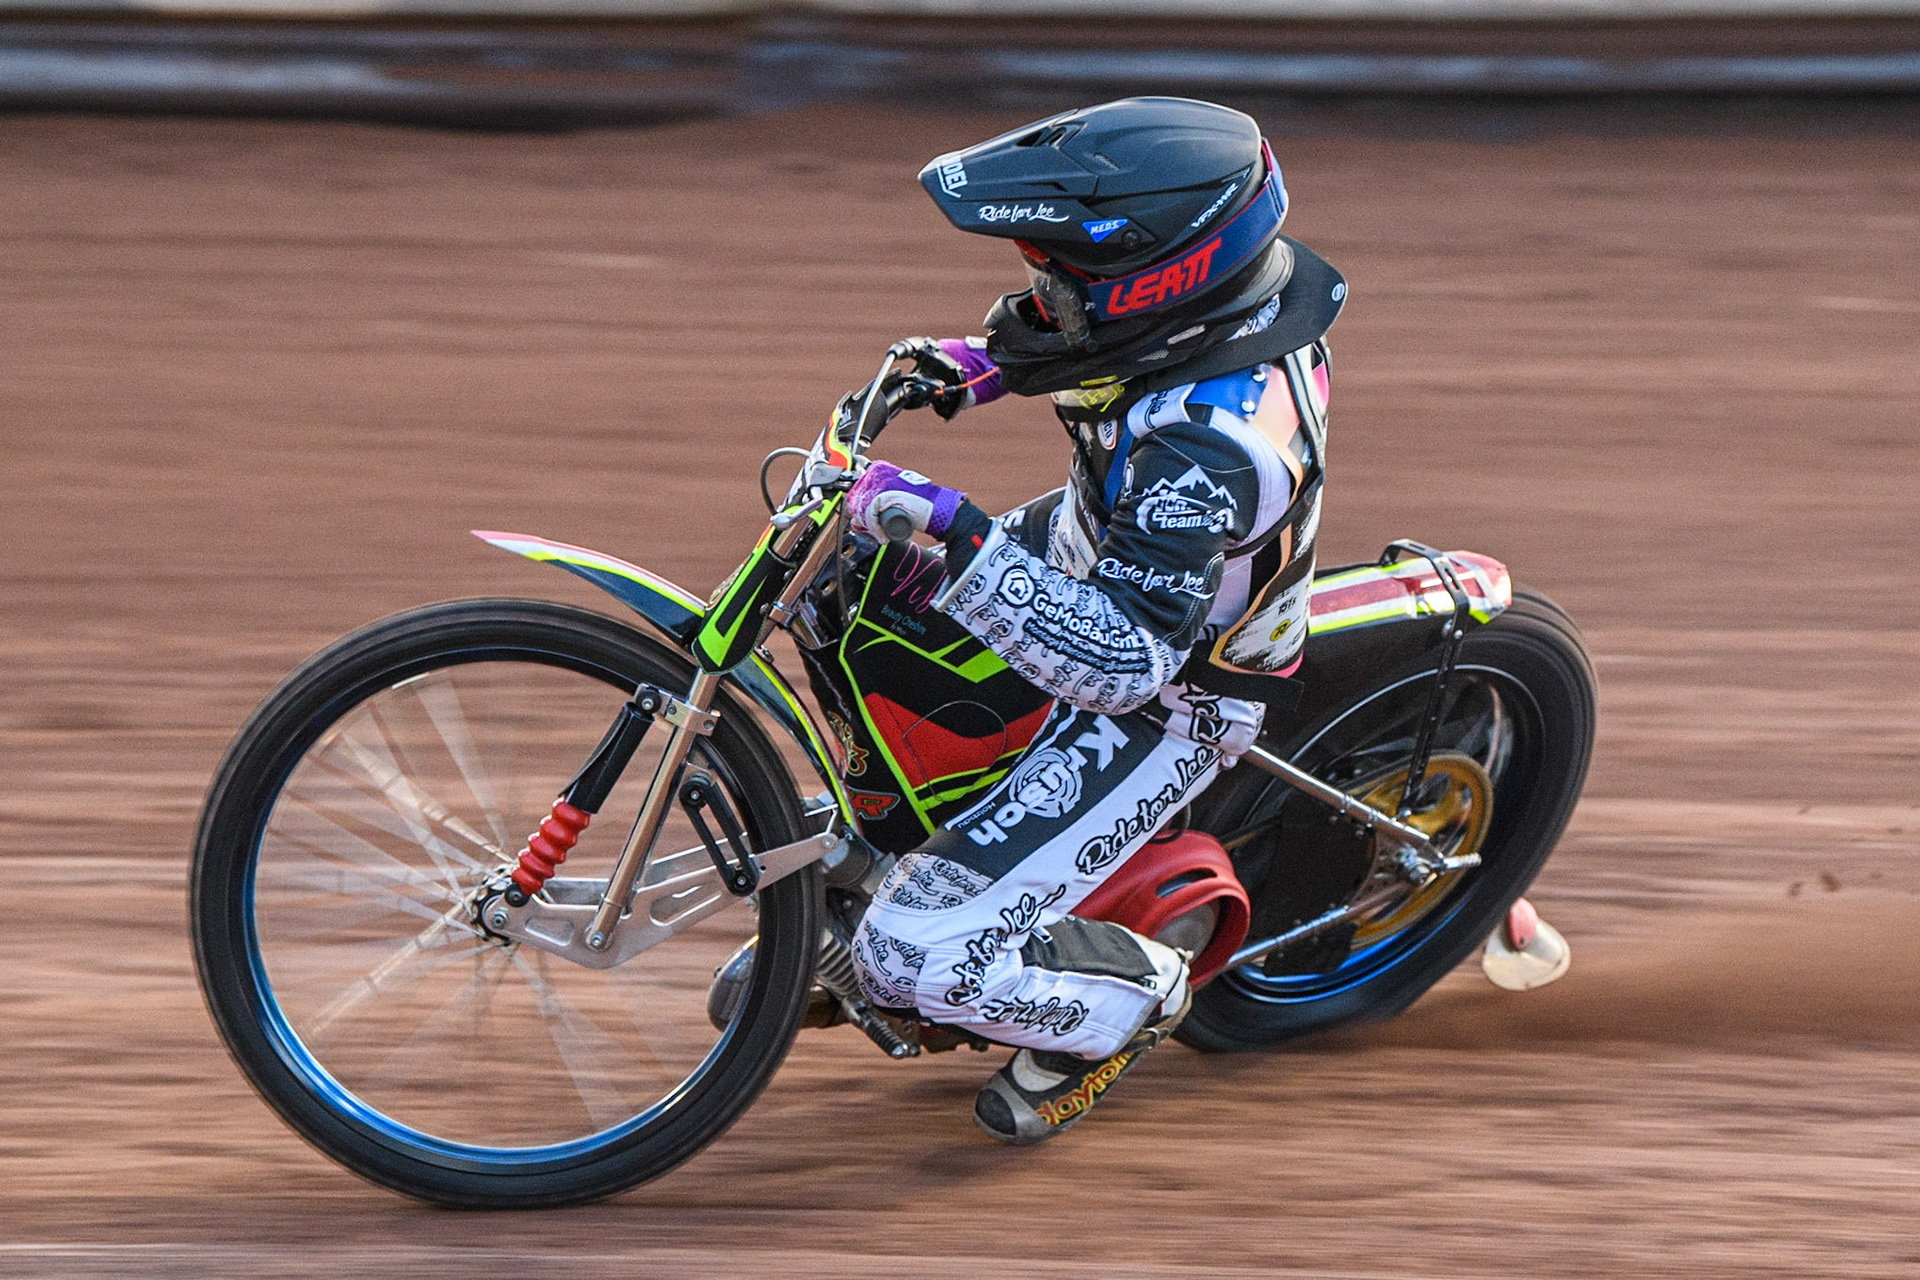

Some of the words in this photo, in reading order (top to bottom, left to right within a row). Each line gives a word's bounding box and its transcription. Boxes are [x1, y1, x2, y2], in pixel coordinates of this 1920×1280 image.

[979, 205, 1011, 222] Ride
[1010, 204, 1032, 223] for
[1028, 203, 1070, 223] Lee
[1106, 237, 1222, 315] LEATT
[1097, 557, 1143, 583] Ride
[1142, 567, 1175, 592] for
[1168, 570, 1214, 600] Lee
[967, 714, 1130, 846] Krusch
[1075, 818, 1142, 875] Ride
[1137, 784, 1180, 832] for
[1174, 745, 1224, 801] Lee
[957, 801, 996, 829] Holzbau
[1000, 884, 1066, 944] Lee
